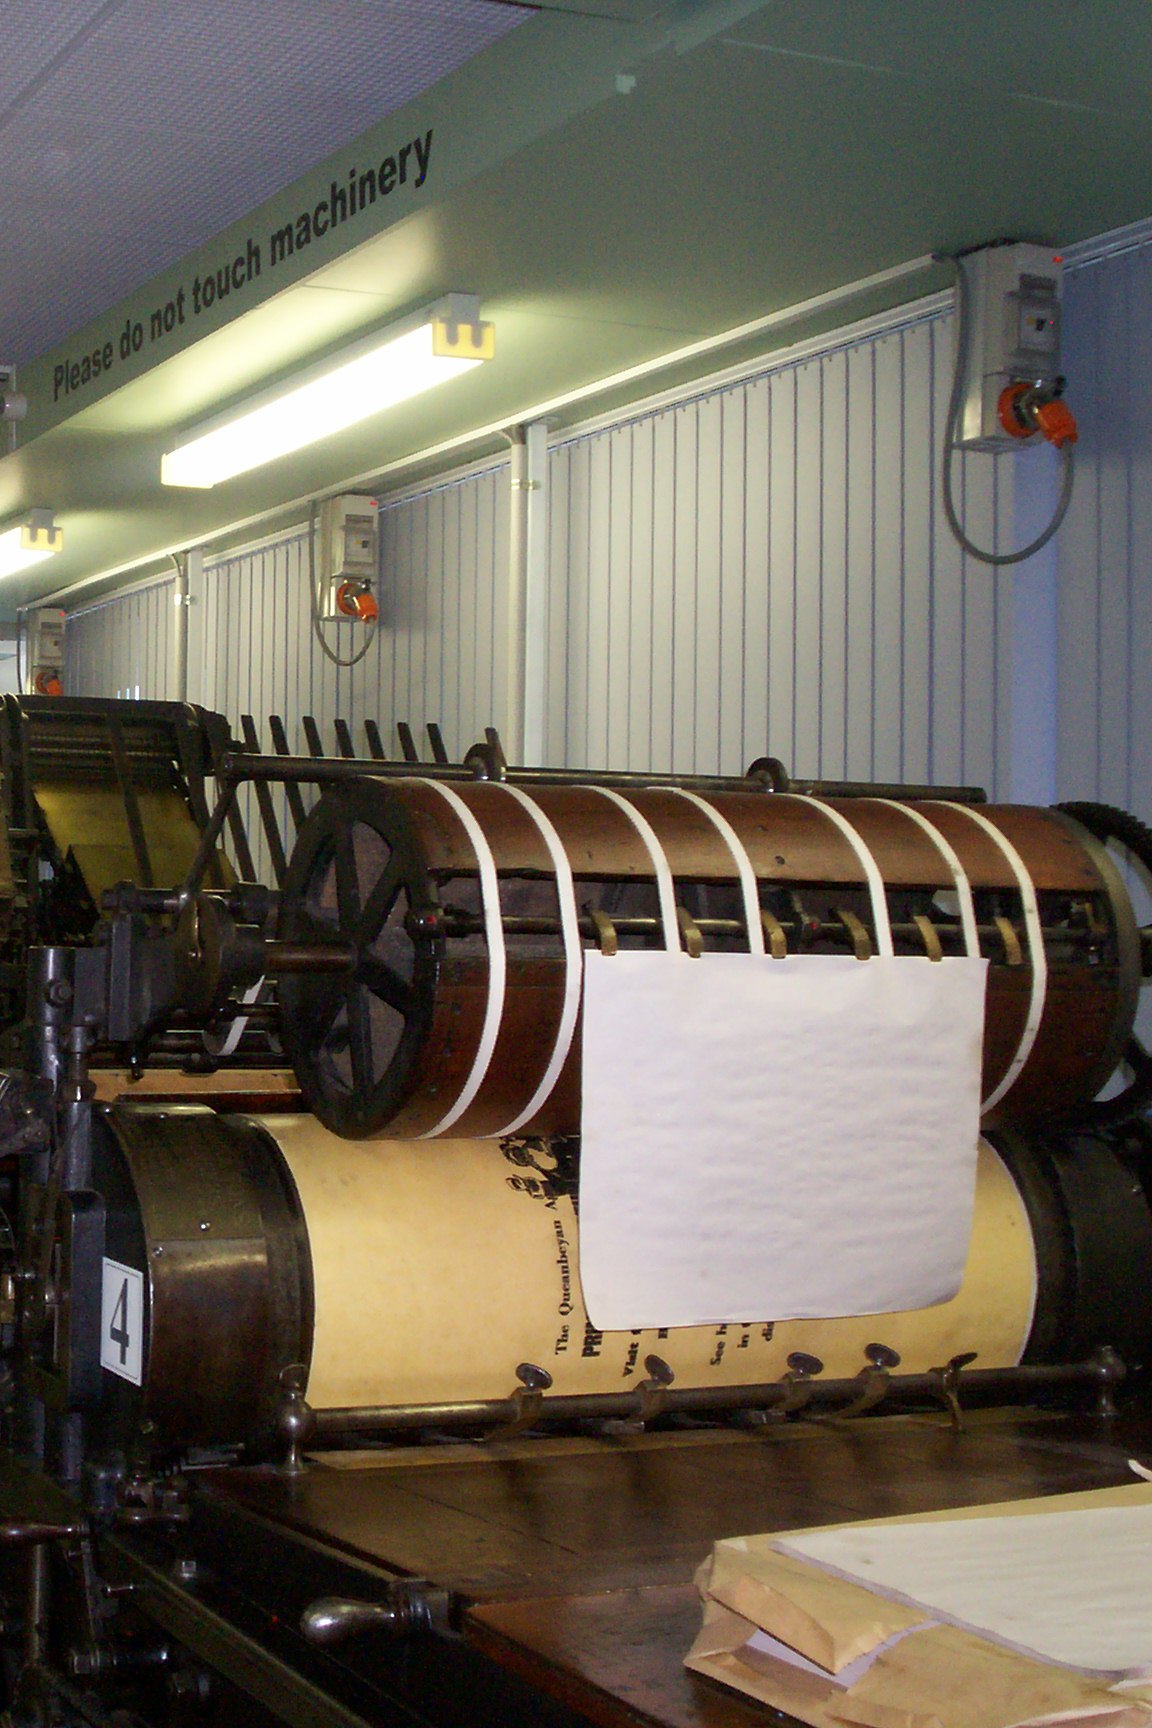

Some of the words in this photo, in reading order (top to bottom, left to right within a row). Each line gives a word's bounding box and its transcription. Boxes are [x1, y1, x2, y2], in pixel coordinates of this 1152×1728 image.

[53, 345, 113, 401] Please
[119, 319, 143, 361] do
[150, 286, 186, 342] not
[192, 239, 260, 315] touch
[270, 128, 434, 266] machinery
[554, 1220, 574, 1316] Queanbeyan
[110, 1278, 130, 1366] 4
[555, 1325, 569, 1355] The
[709, 1341, 726, 1366] See
